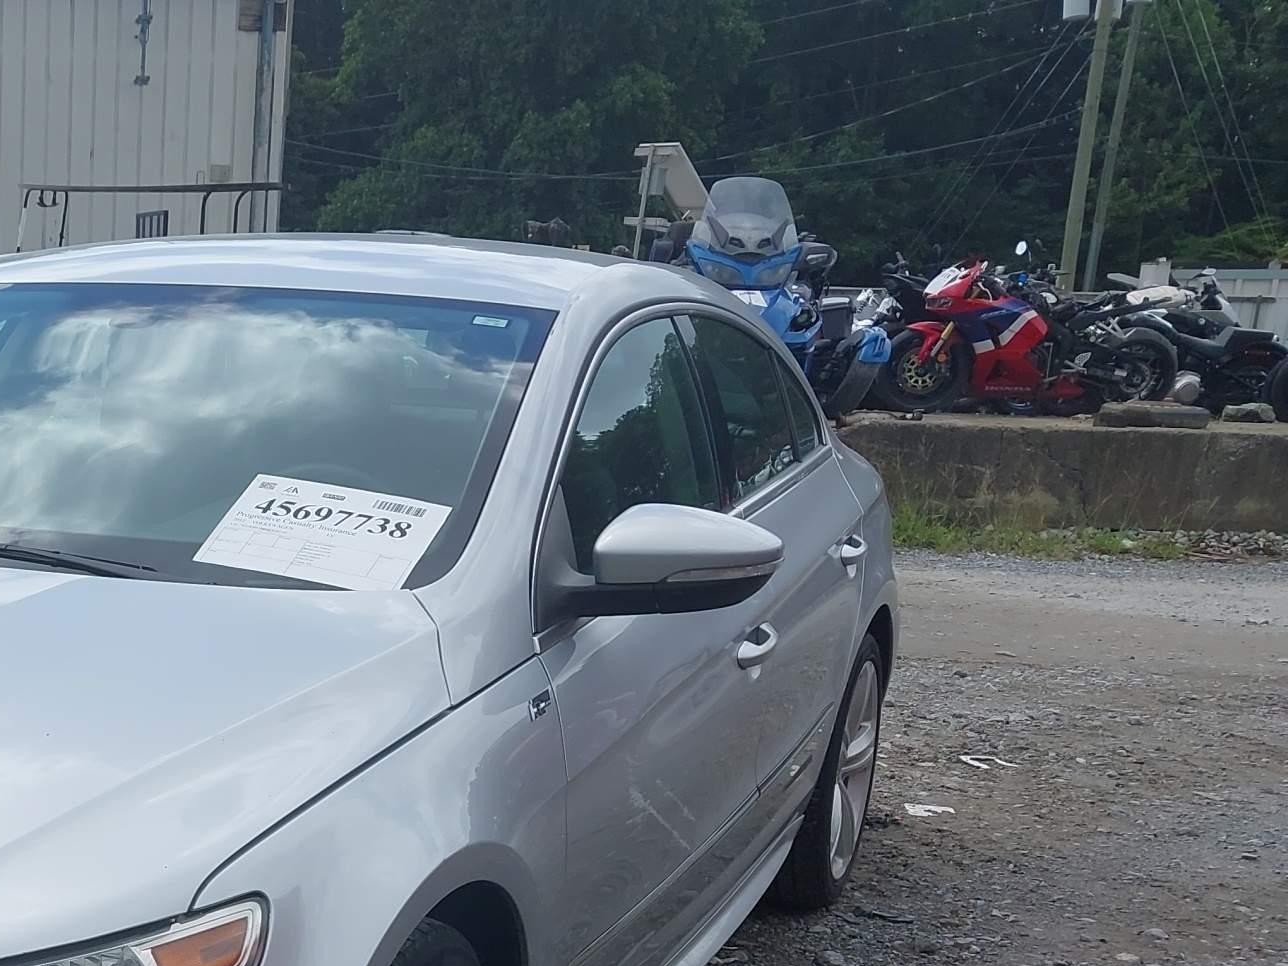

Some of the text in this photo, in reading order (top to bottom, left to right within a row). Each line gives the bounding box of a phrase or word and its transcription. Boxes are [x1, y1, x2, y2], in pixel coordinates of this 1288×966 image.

[236, 511, 282, 523] Progressive
[282, 518, 316, 529] Casualty
[318, 523, 357, 536] Insurance
[255, 498, 412, 539] 45697738
